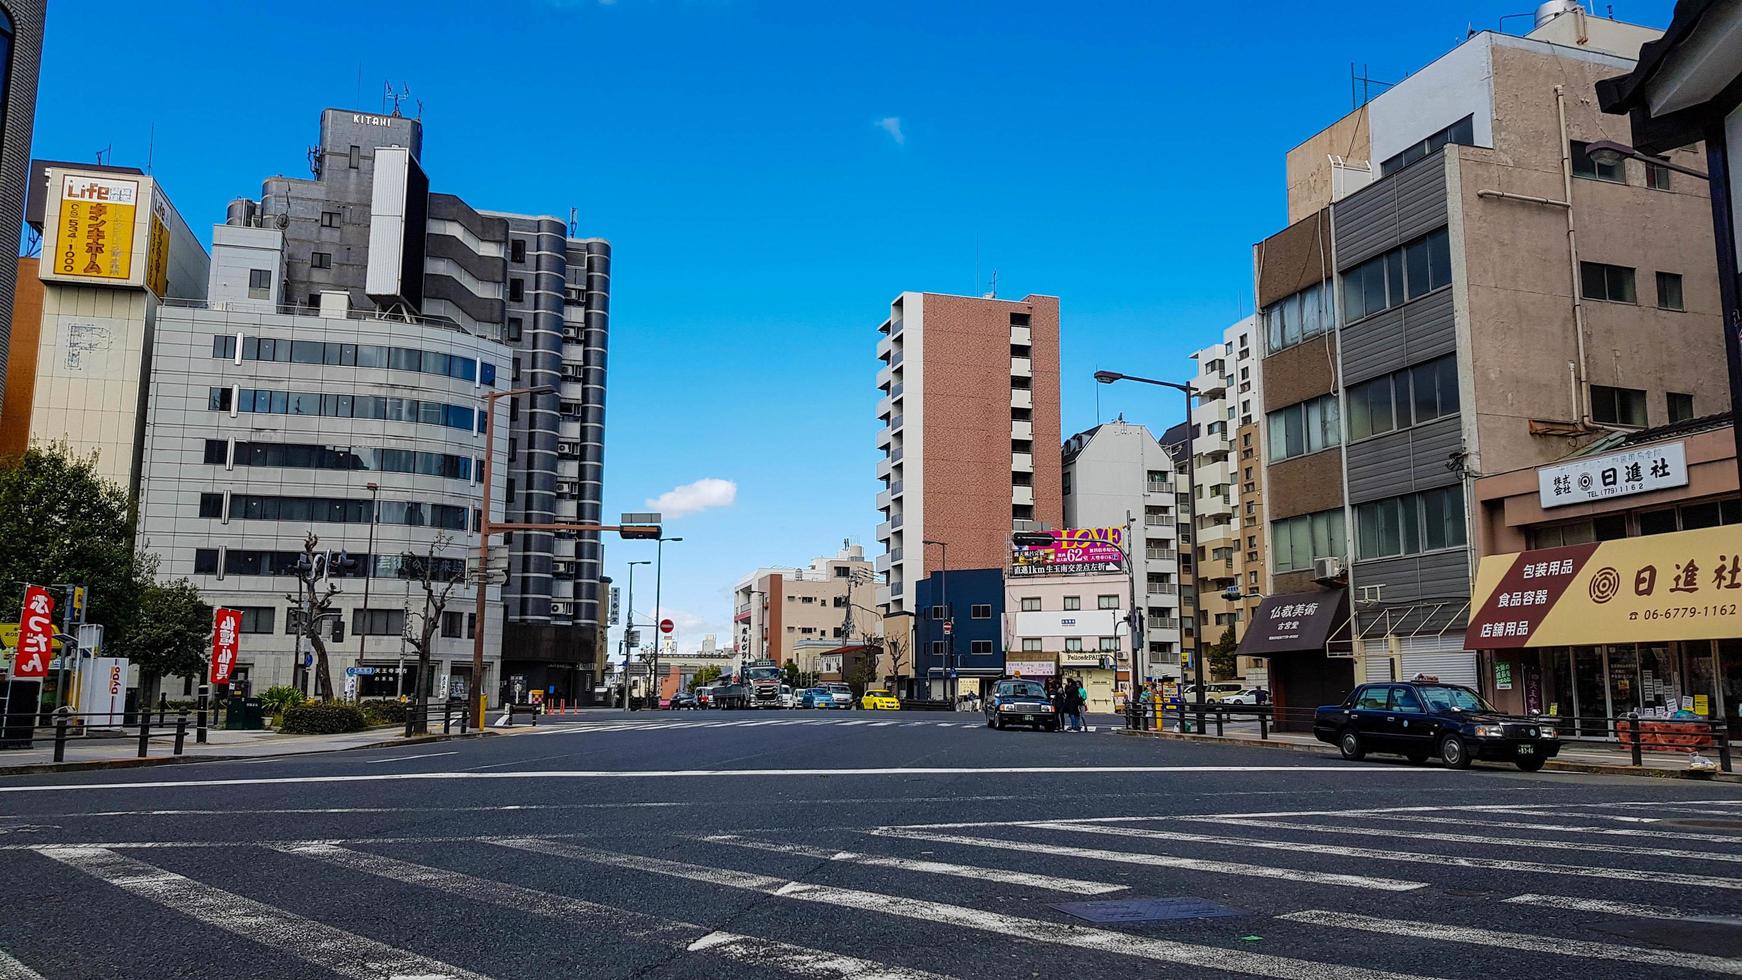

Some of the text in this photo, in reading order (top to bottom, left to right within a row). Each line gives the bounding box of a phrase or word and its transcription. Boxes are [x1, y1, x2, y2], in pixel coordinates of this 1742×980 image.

[67, 180, 110, 201] Life
[1553, 474, 1571, 486] 株式
[1601, 457, 1671, 487] 日進社
[1553, 484, 1572, 497] 会社
[1588, 490, 1599, 499] TEL
[1061, 527, 1122, 550] LOVE
[1523, 559, 1573, 579] 包装用品
[1634, 554, 1742, 597] 日進社
[1497, 589, 1548, 608] 食品容器
[1270, 602, 1319, 619] 仏教美術
[1644, 604, 1737, 621] 06-6779-1162
[1480, 621, 1529, 638] 店舗用品
[111, 666, 121, 695] DyDo
